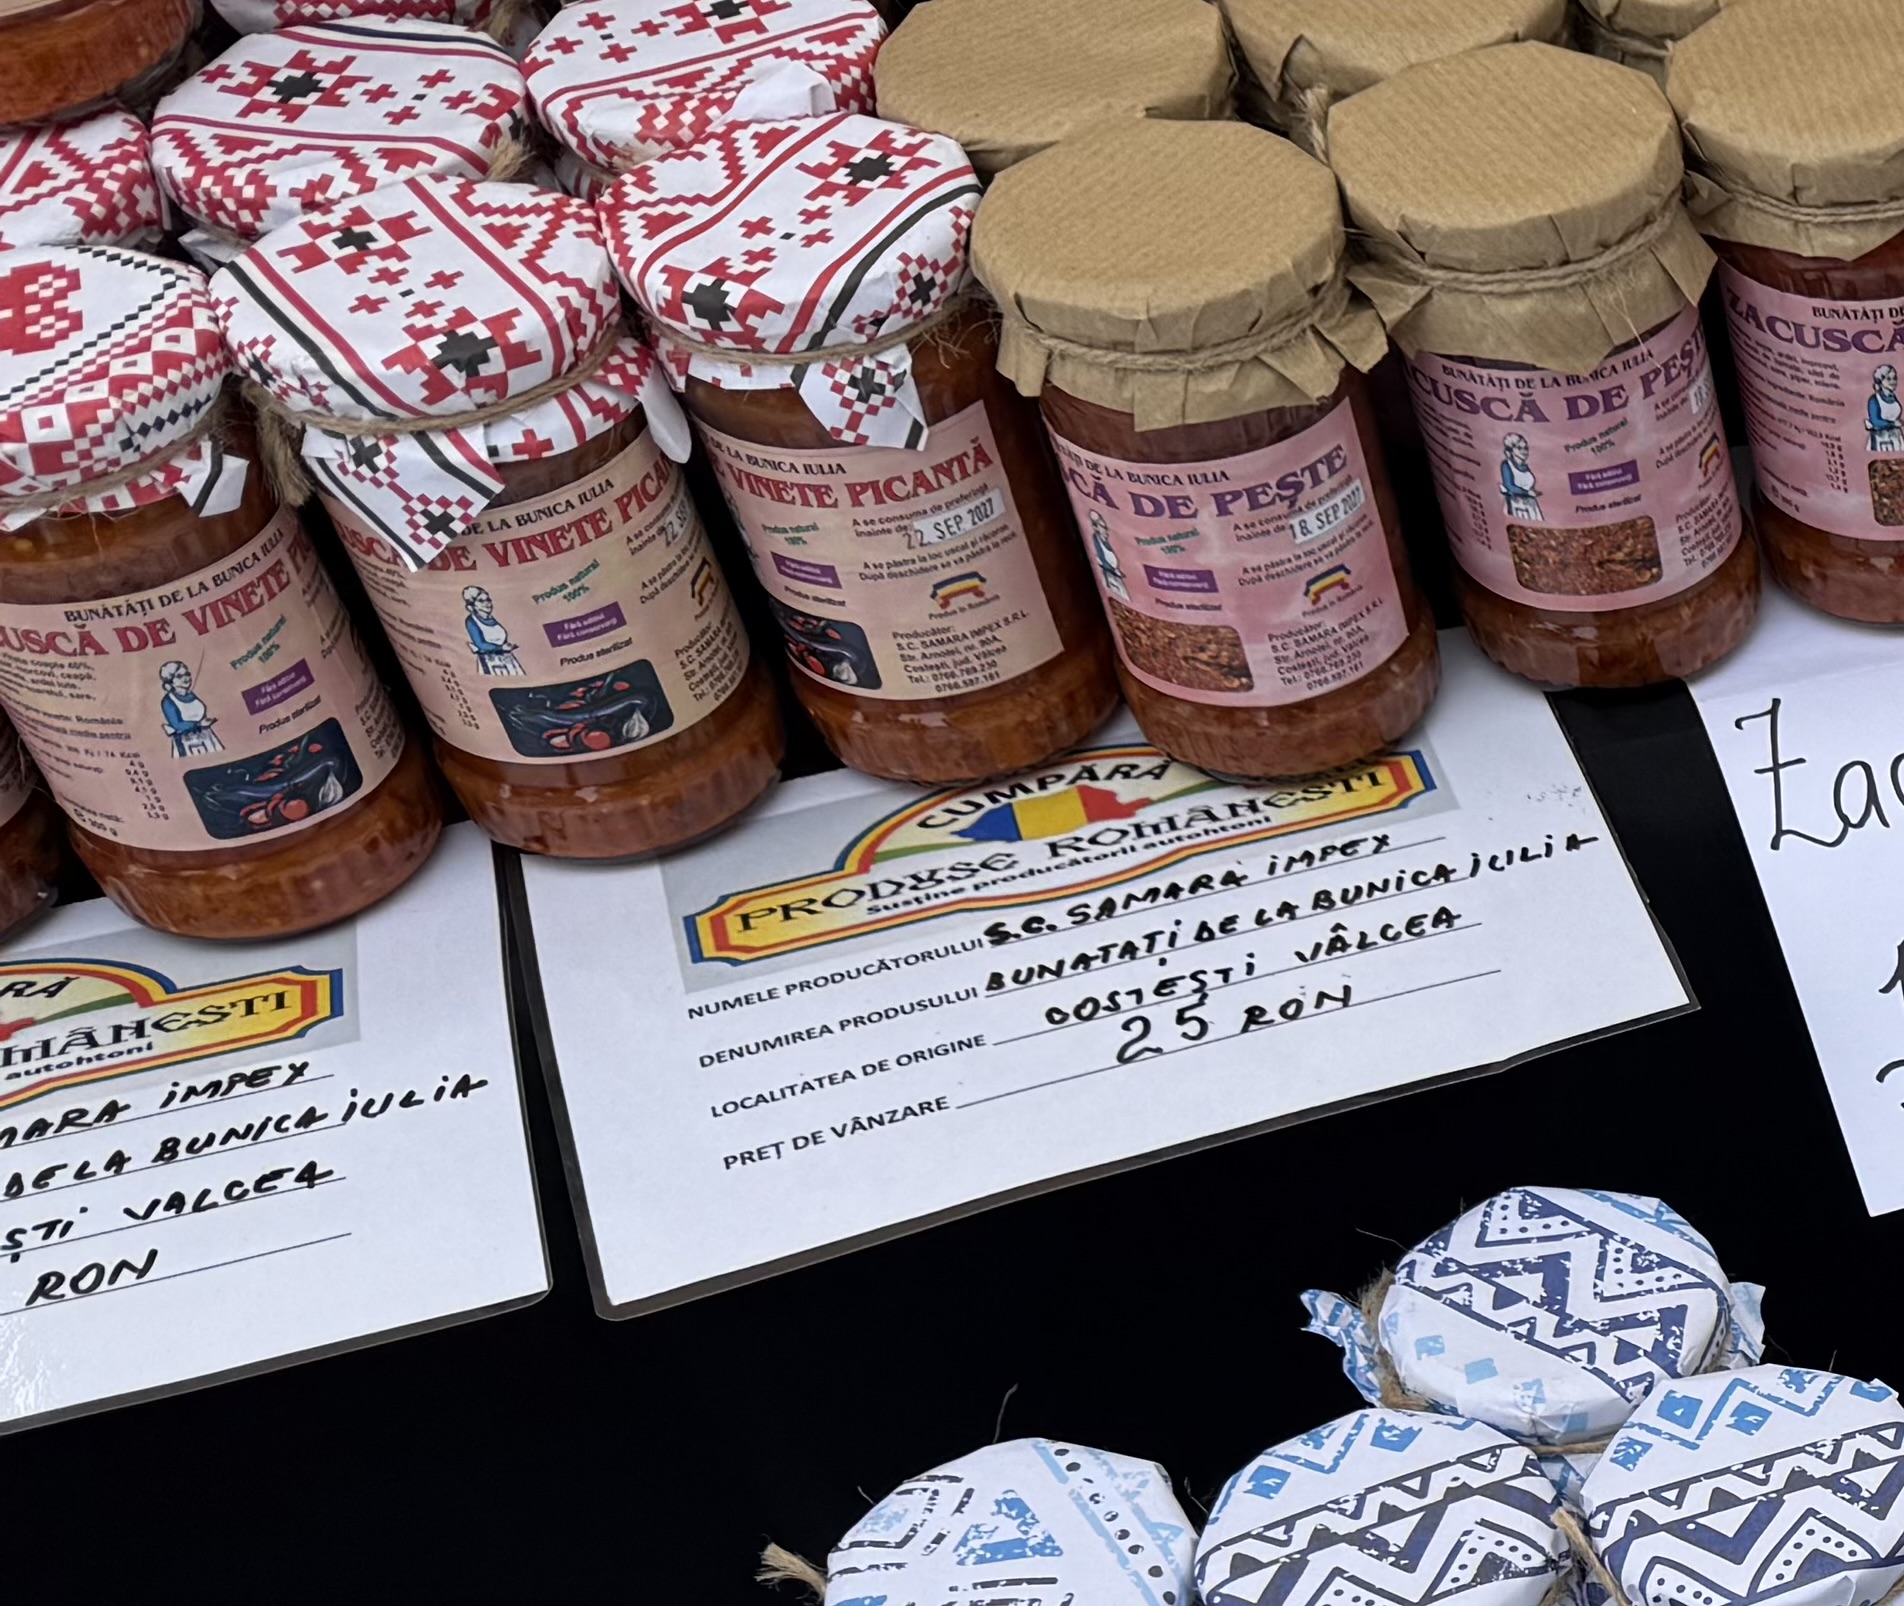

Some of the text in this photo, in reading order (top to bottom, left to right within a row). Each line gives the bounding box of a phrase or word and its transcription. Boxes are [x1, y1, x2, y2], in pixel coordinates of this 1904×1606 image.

[1564, 384, 1630, 421] DE
[728, 465, 838, 509] VINETE
[1129, 491, 1198, 519] DE
[483, 512, 614, 568] VINETE
[112, 559, 292, 654] DE VINETE
[688, 988, 781, 1020] NUMELE
[785, 938, 984, 997] PRODUCĂTORULUI
[1066, 869, 1249, 927] SAMARA
[699, 1025, 834, 1069] DENUMIREA
[840, 987, 978, 1032] PRODUSULUI
[1194, 915, 1240, 943] DE
[1254, 901, 1300, 927] LA
[1312, 862, 1457, 912] BUNICA
[4, 1041, 153, 1080] autohtoni
[160, 1061, 309, 1109] IMPEX
[711, 1069, 857, 1119] LOCALITATEA
[862, 1060, 891, 1077] DE
[895, 1035, 987, 1067] ORIGINE
[722, 984, 1354, 1170] PREȚ DE VÂNZARE 25 RON
[152, 1105, 328, 1165] BUNICA
[123, 1161, 334, 1222] VALCEA
[24, 1249, 158, 1307] RON
